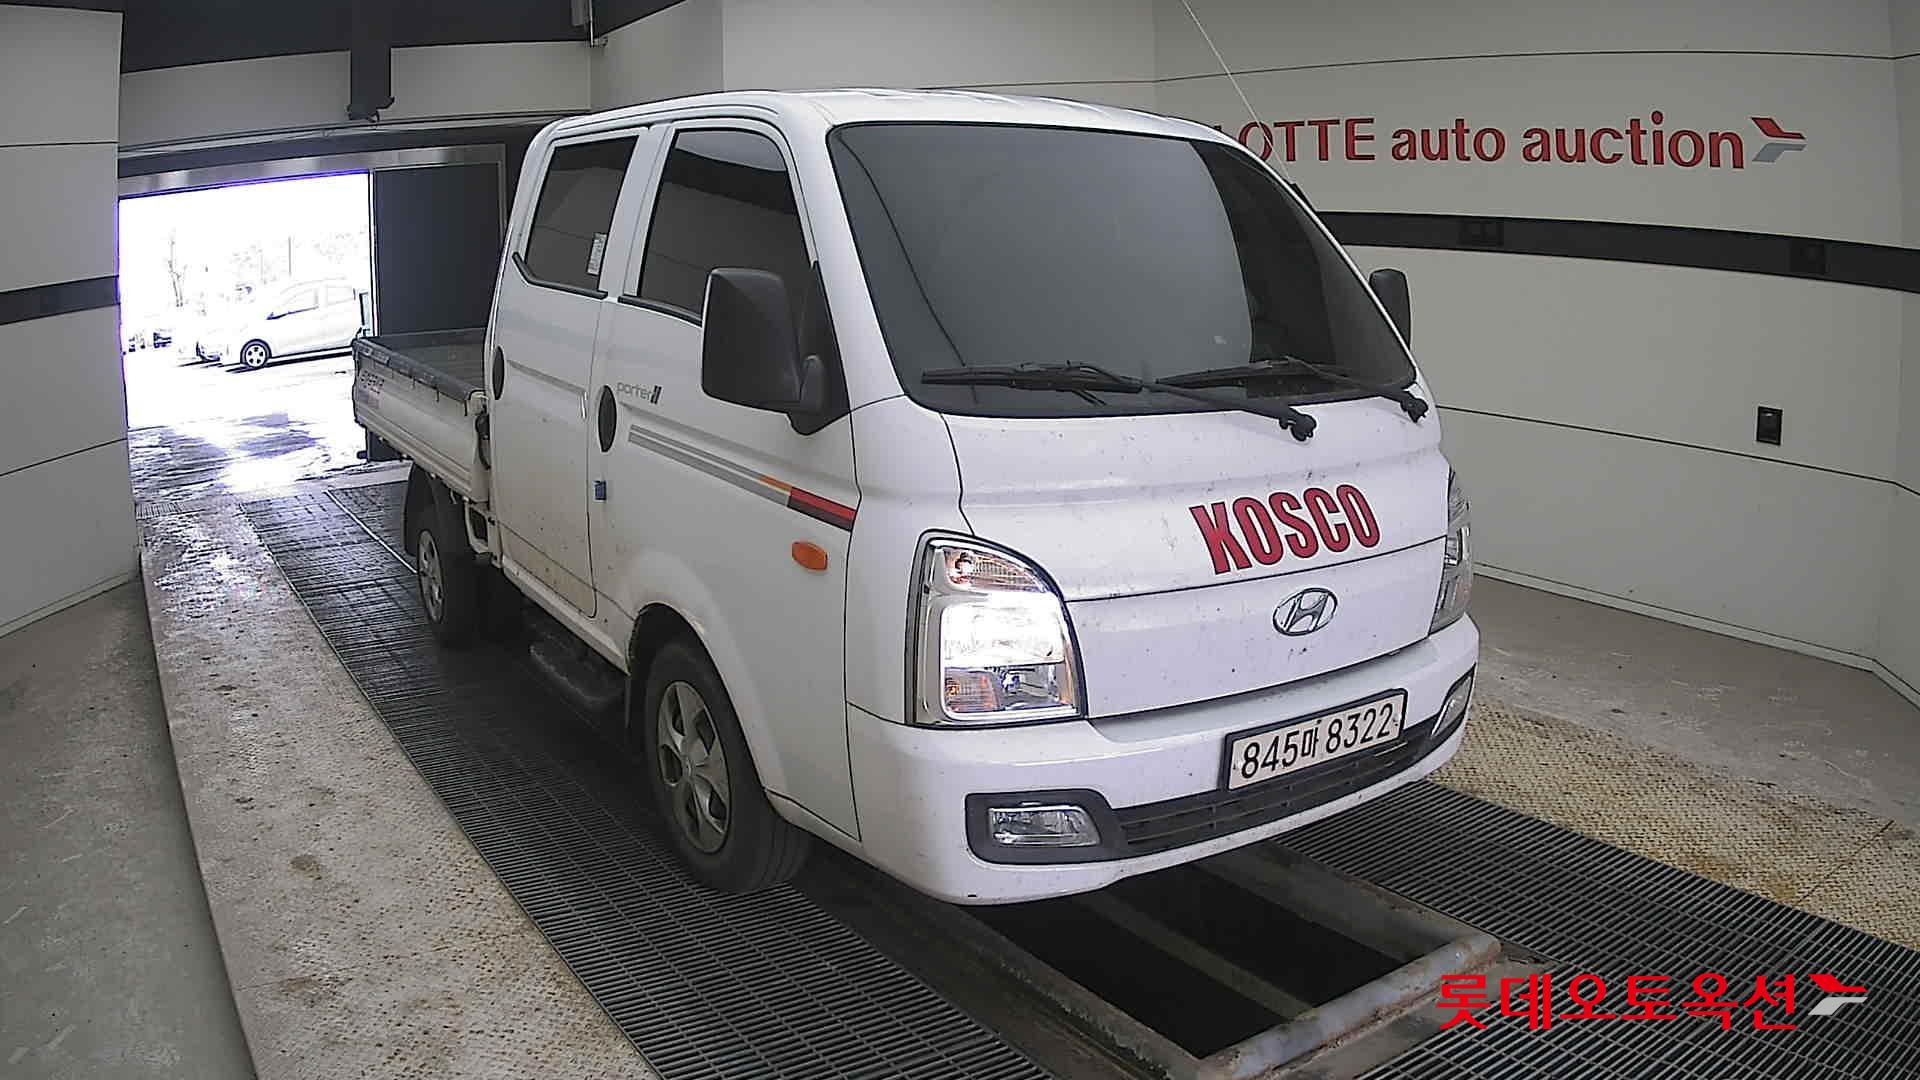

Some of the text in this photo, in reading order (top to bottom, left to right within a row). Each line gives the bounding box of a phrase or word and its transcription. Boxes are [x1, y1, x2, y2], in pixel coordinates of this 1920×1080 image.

[1213, 110, 1745, 169] OTTE auto auction
[1188, 484, 1381, 575] KOSCO
[1325, 703, 1394, 754] 8322
